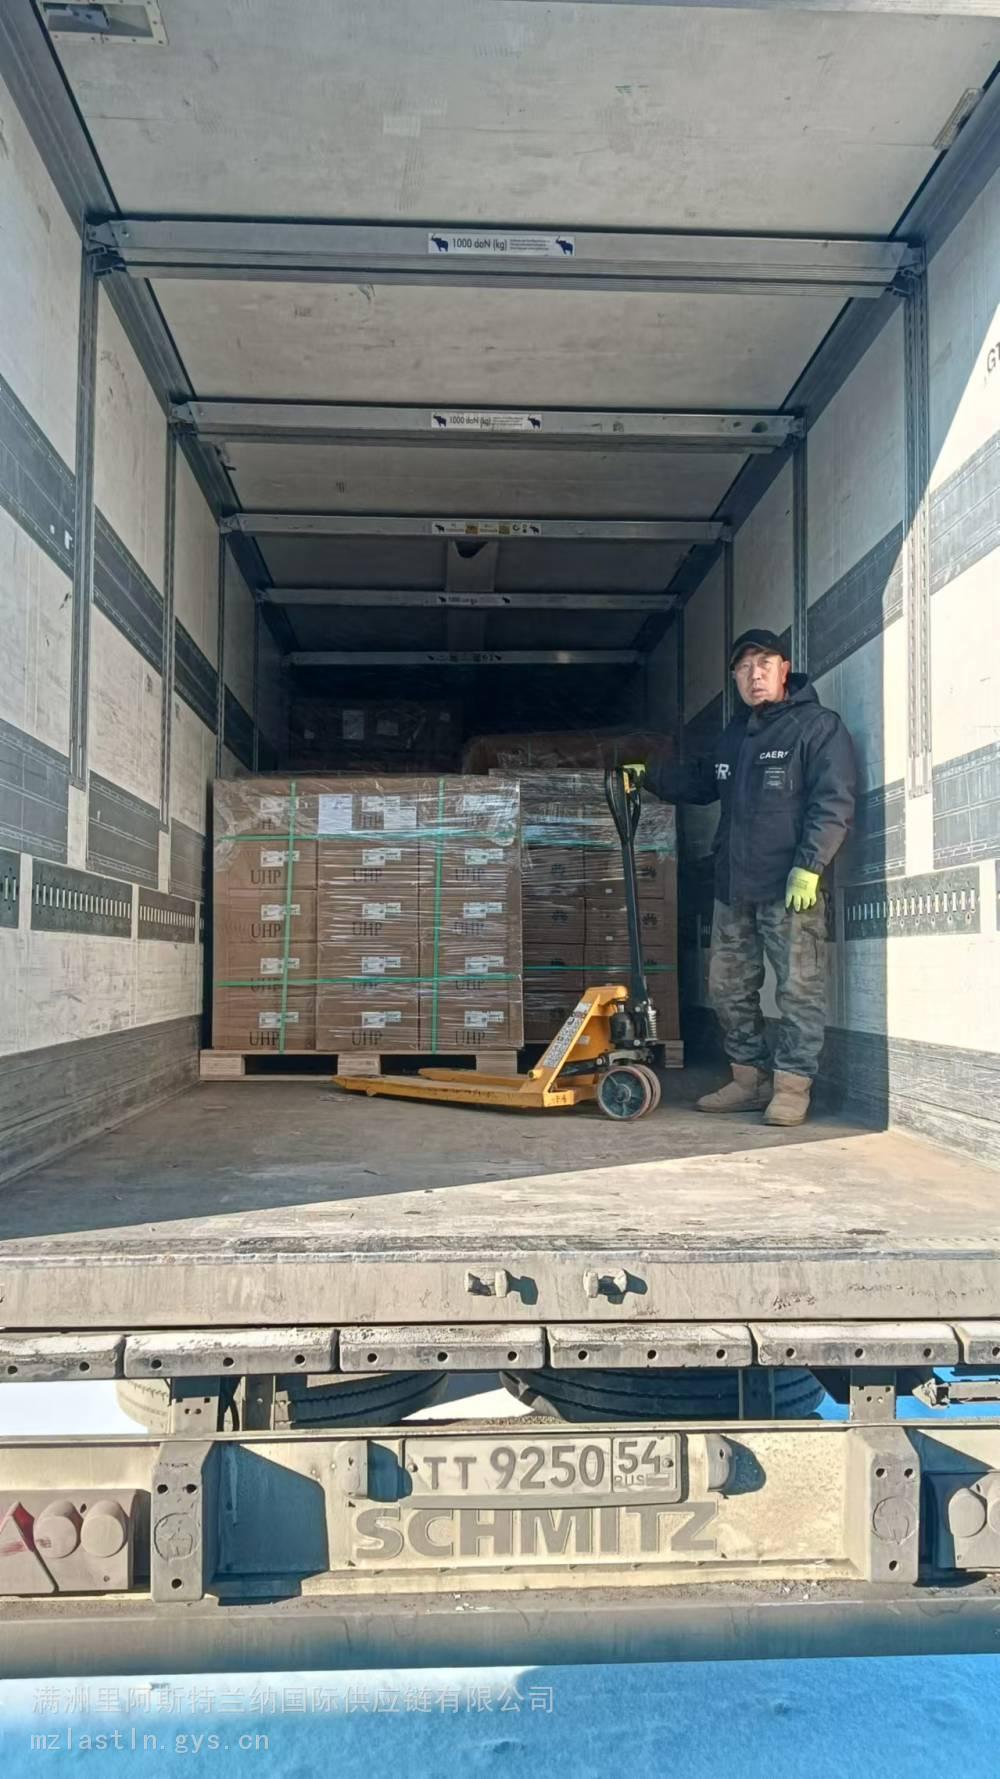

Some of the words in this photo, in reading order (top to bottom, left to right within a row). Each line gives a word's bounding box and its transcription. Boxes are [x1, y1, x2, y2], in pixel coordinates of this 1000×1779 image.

[452, 237, 473, 248] 1000
[474, 238, 491, 248] daN
[250, 869, 281, 884] UHP
[251, 923, 281, 938] UHP
[352, 921, 383, 936] UHP
[249, 1031, 280, 1046] UHP
[352, 1031, 383, 1046] UHP
[489, 1446, 605, 1490] 9250
[617, 1440, 663, 1475] 54
[613, 1475, 645, 1488] RUS
[355, 1503, 717, 1559] SCHMITZ
